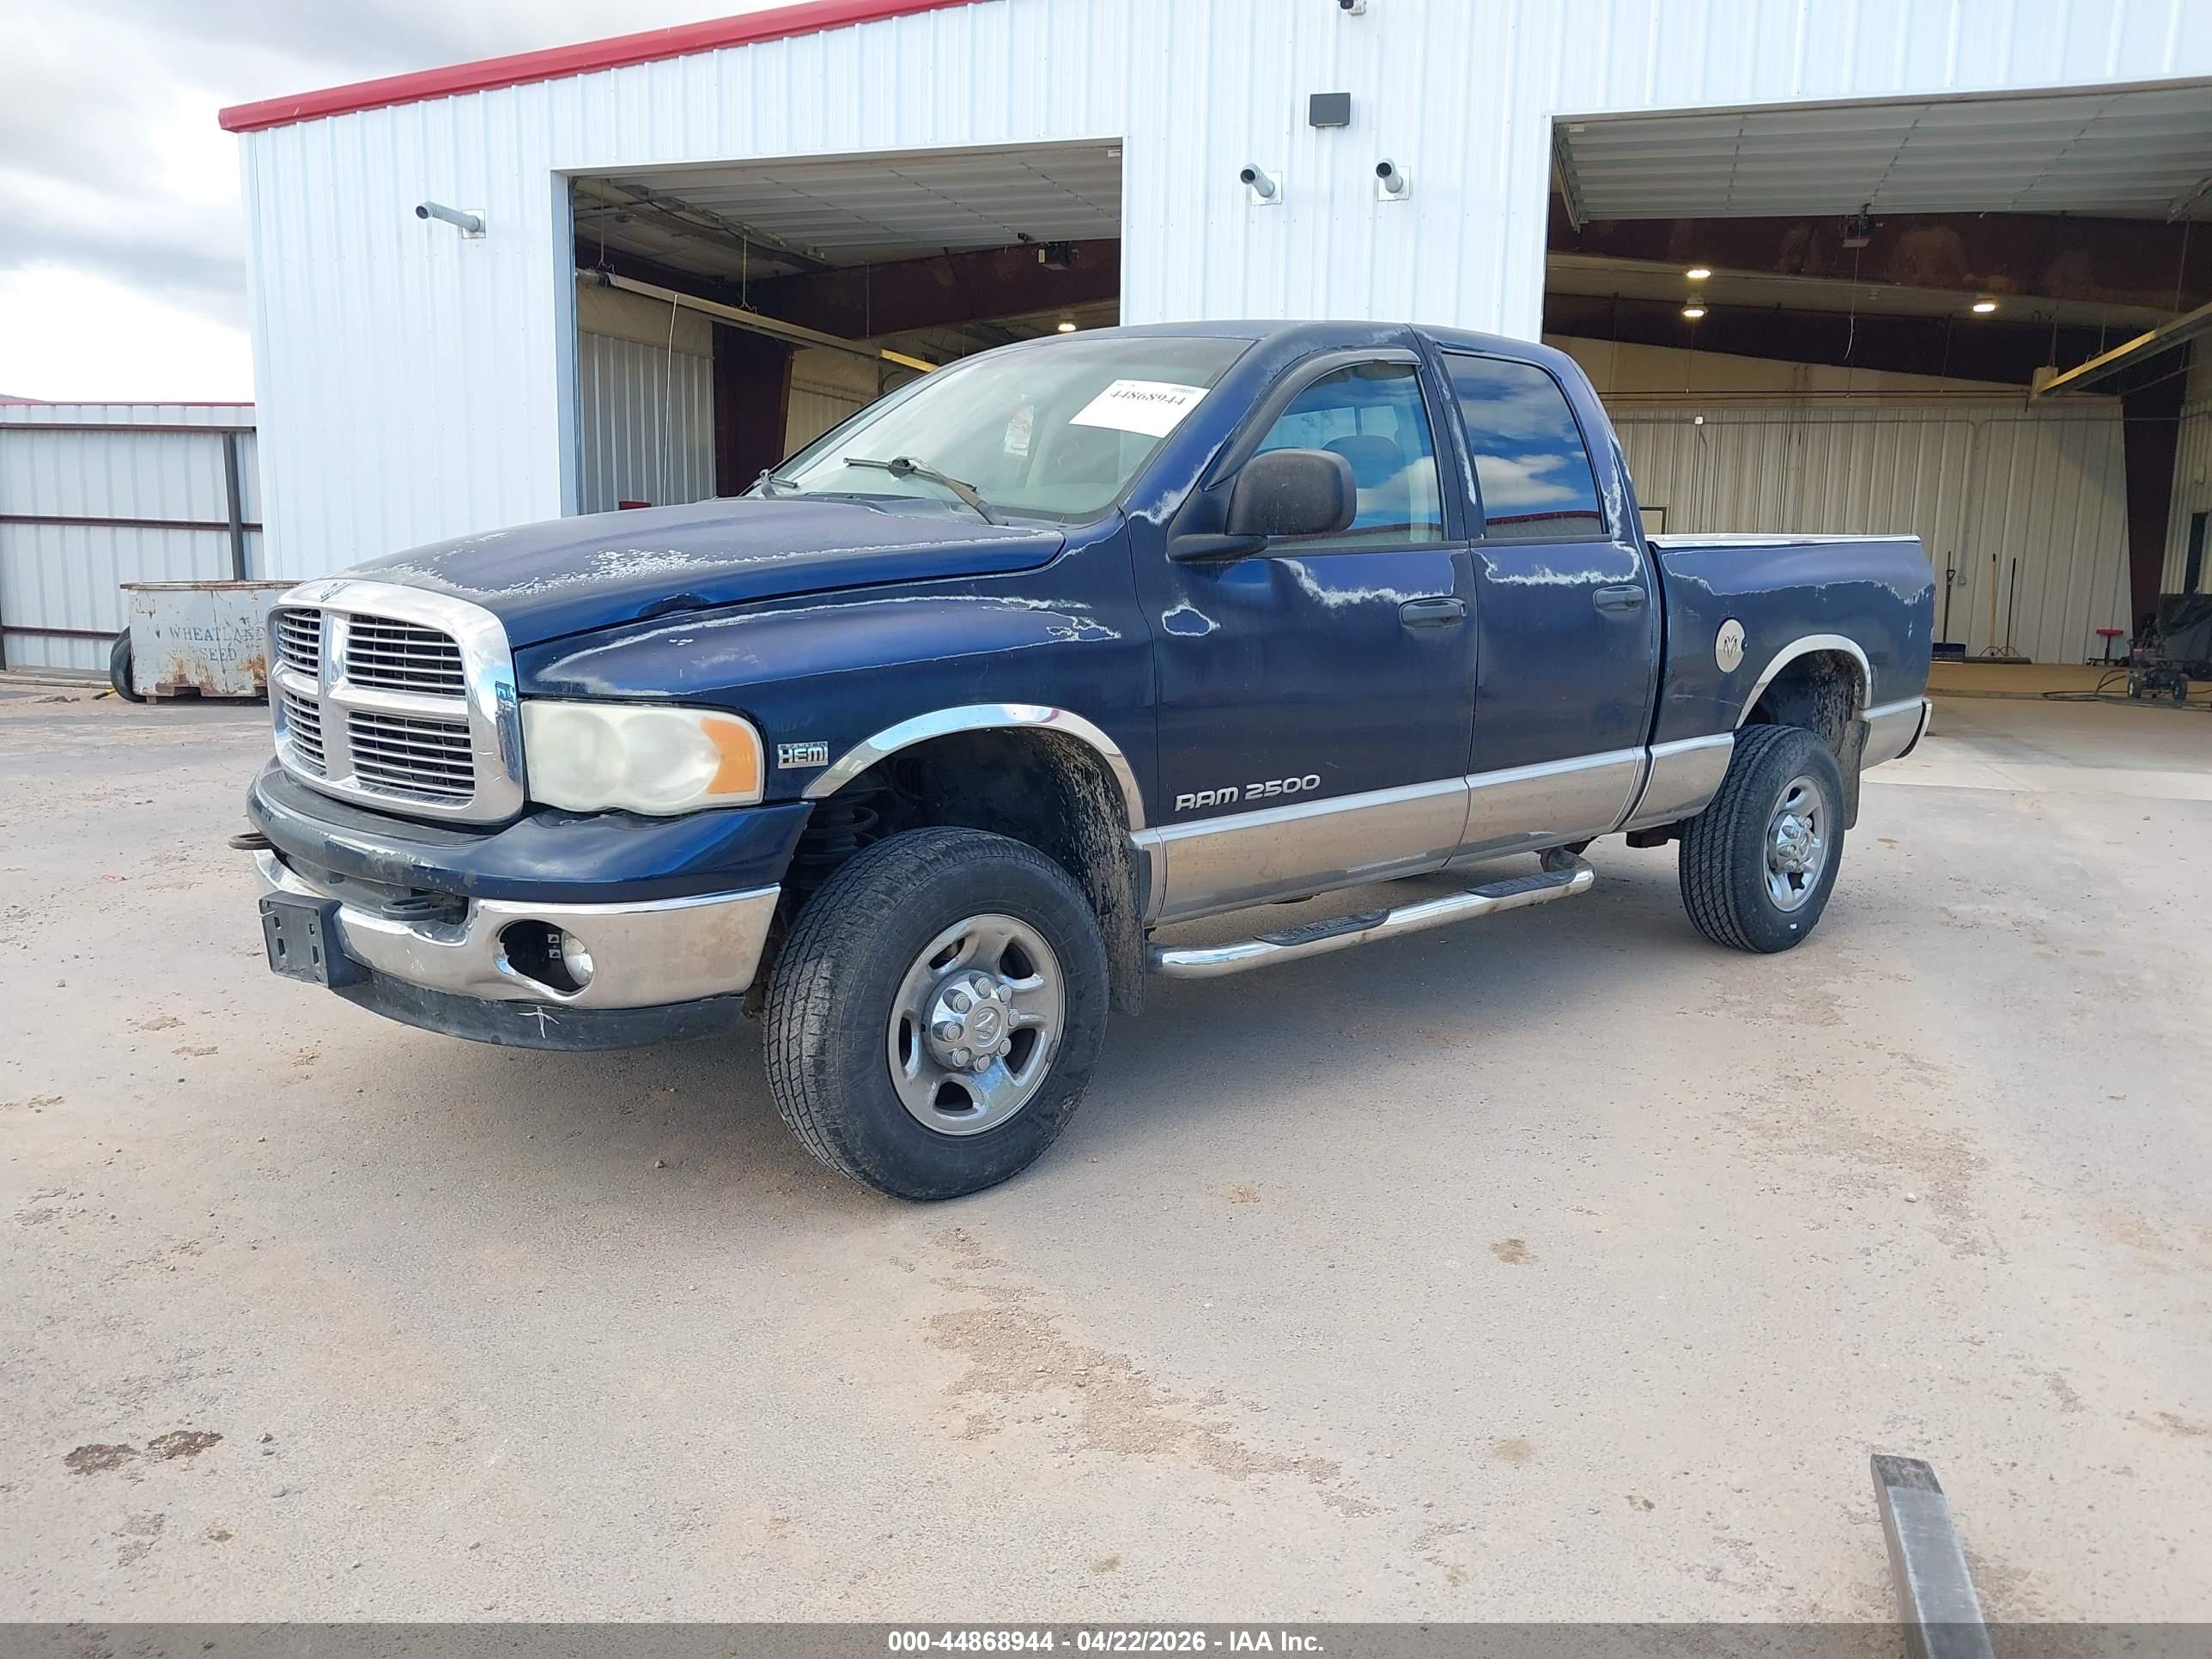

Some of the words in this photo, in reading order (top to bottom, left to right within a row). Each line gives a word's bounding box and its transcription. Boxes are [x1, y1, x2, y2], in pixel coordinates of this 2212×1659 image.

[1109, 389, 1187, 406] 44868944
[169, 626, 265, 642] WHEATLAND
[199, 647, 237, 661] SEED
[1174, 786, 1239, 812] RAM
[1245, 774, 1321, 800] 2500
